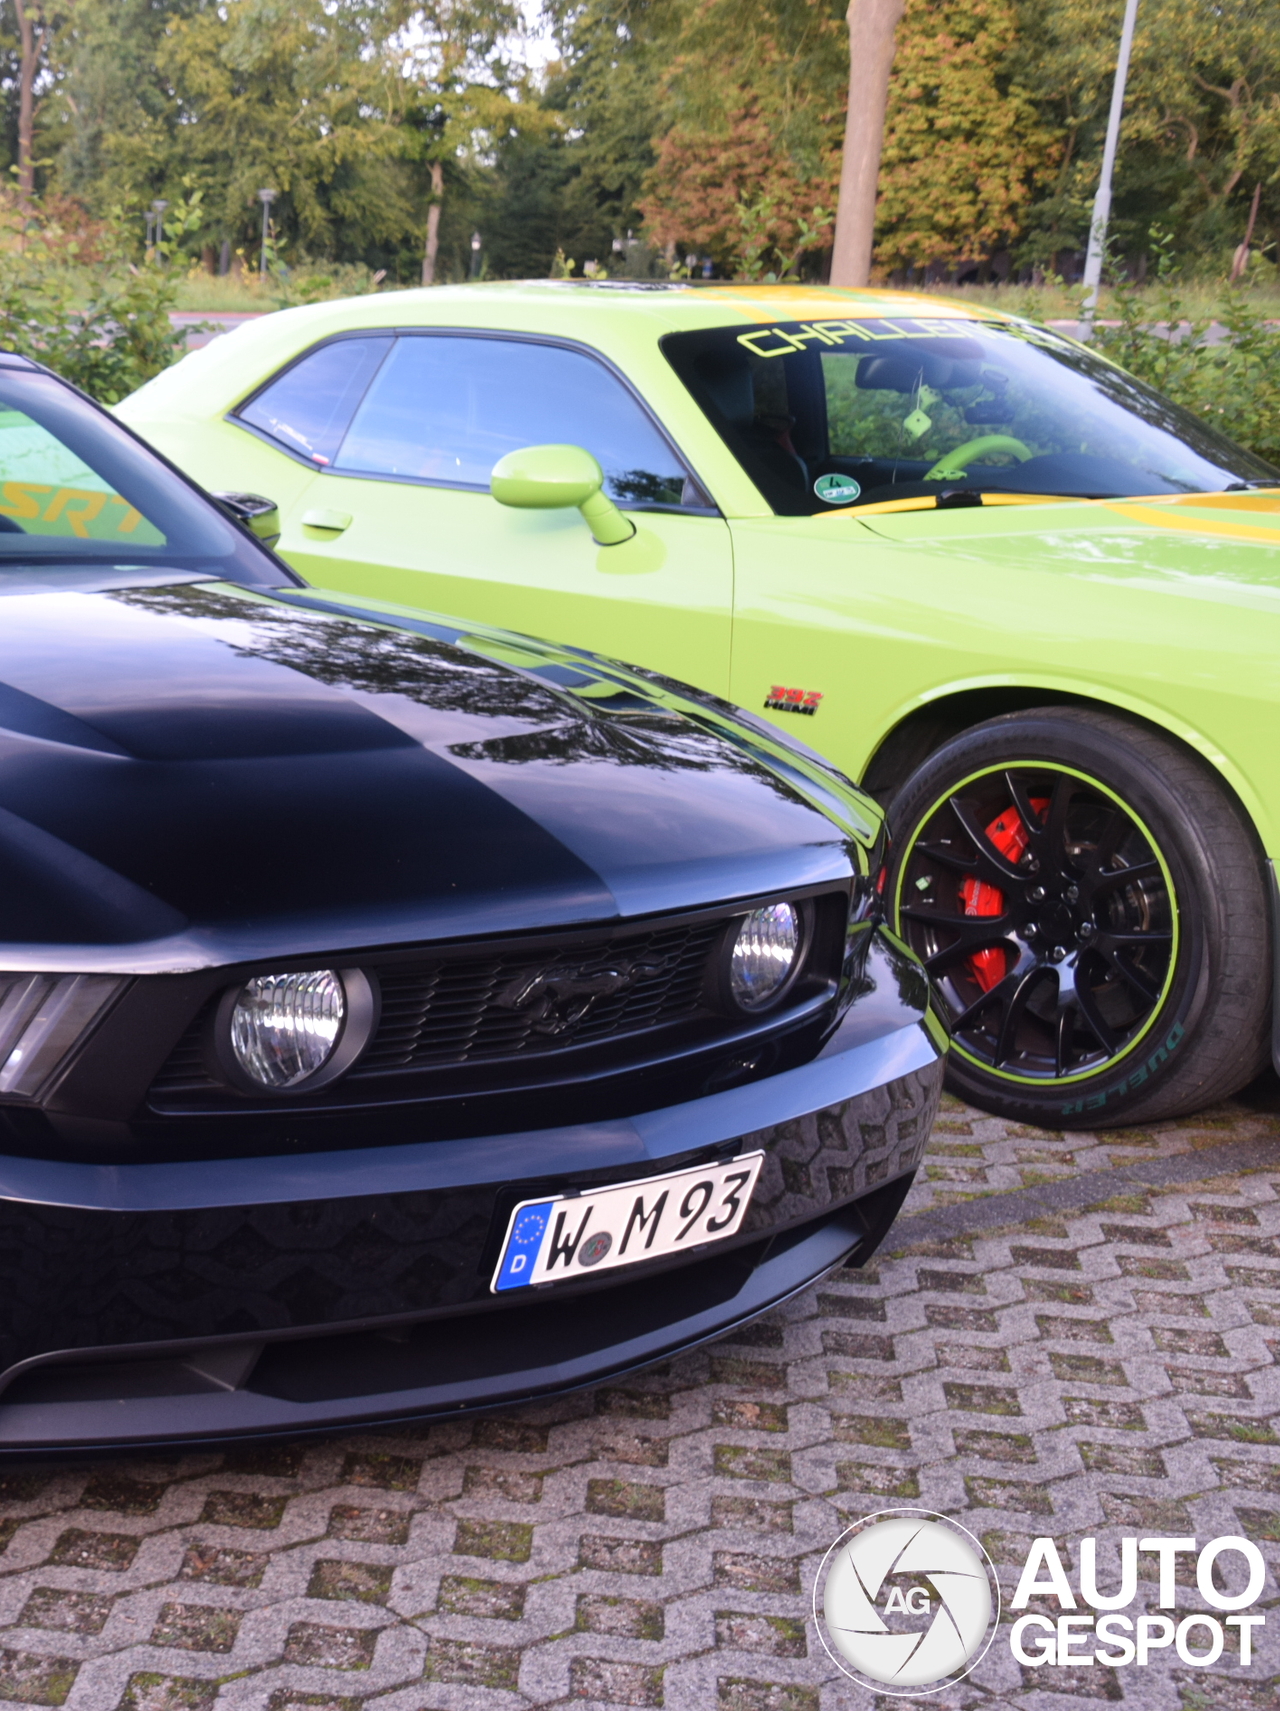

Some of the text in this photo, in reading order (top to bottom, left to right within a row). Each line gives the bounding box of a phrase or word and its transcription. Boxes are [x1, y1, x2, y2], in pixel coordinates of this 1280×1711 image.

[829, 476, 841, 488] 4
[767, 685, 823, 706] 392
[1061, 1020, 1186, 1115] DUELER
[546, 1205, 594, 1271] W
[619, 1189, 670, 1256] M
[674, 1170, 751, 1241] 93
[509, 1254, 527, 1274] D
